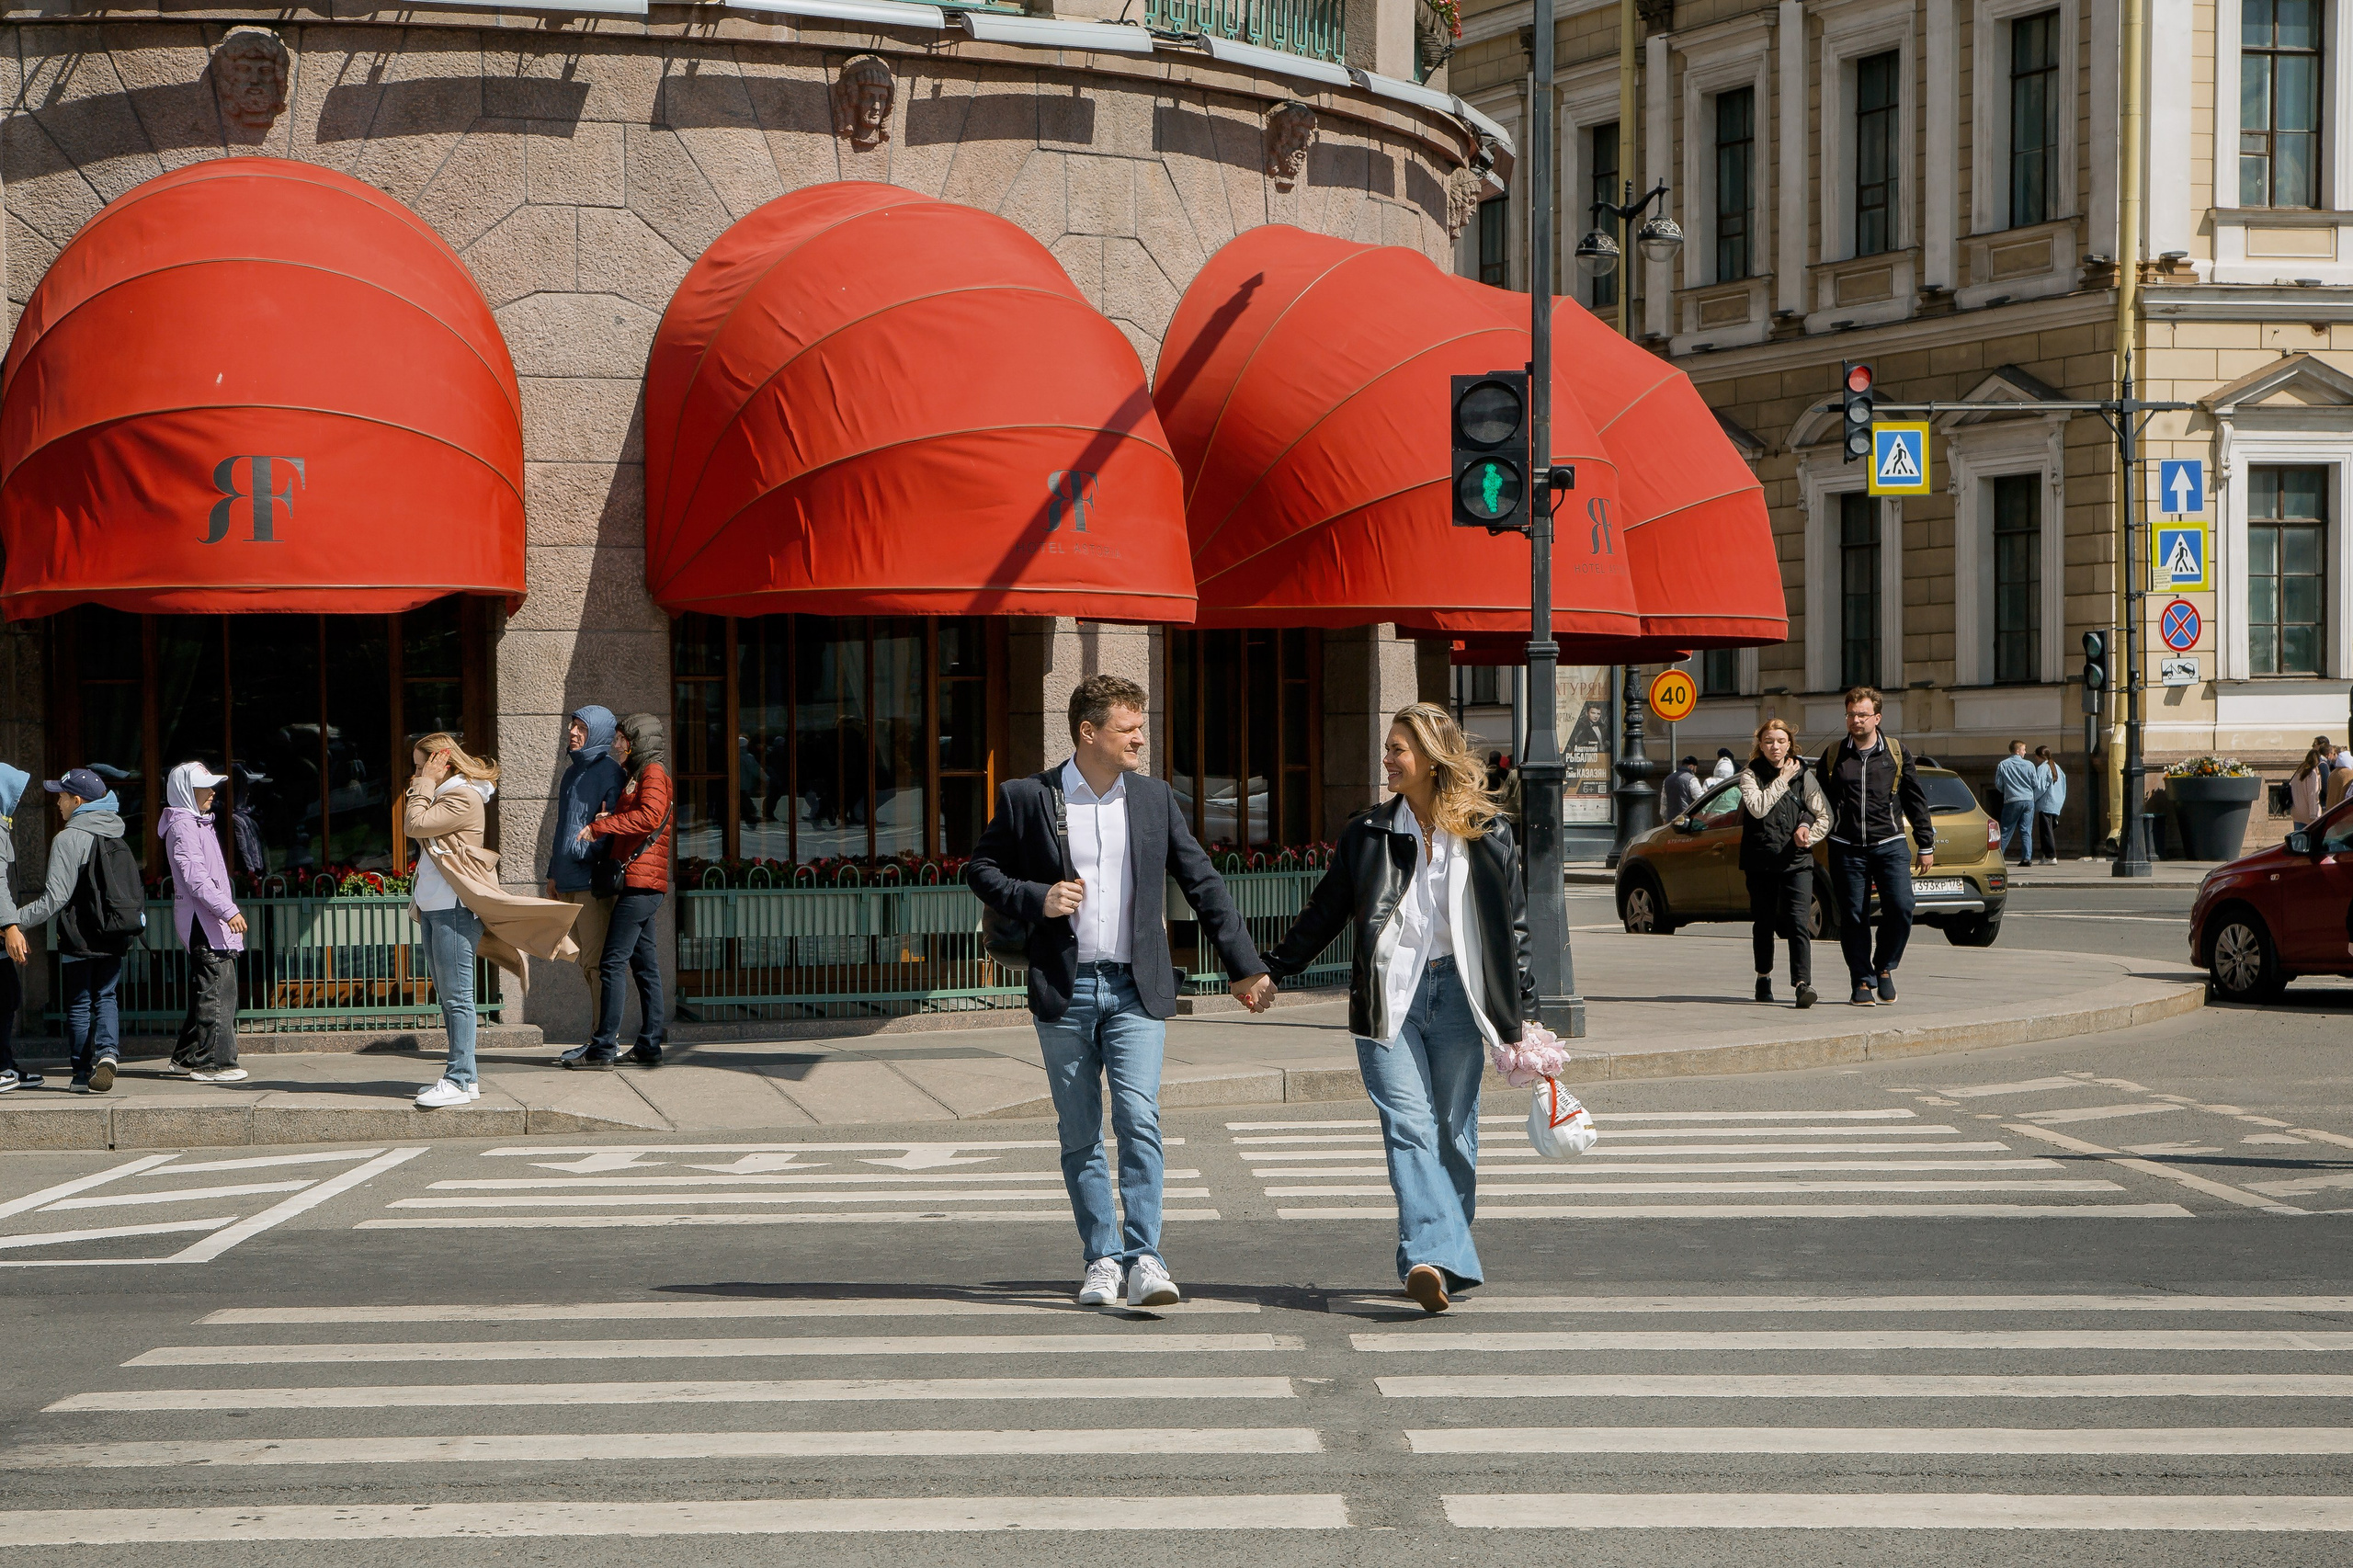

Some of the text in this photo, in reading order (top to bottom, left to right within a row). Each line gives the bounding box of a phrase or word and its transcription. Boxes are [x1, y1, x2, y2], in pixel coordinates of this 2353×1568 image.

[1015, 541, 1065, 554] HOTEL
[1574, 563, 1605, 574] HOTEL
[1660, 686, 1686, 705] 40
[1574, 744, 1598, 753] Анатолий
[1565, 753, 1598, 763] РЫБАЛКО
[1577, 768, 1607, 778] КАЗАЗЯН
[1583, 785, 1595, 793] 6+
[1948, 879, 1961, 888] 178
